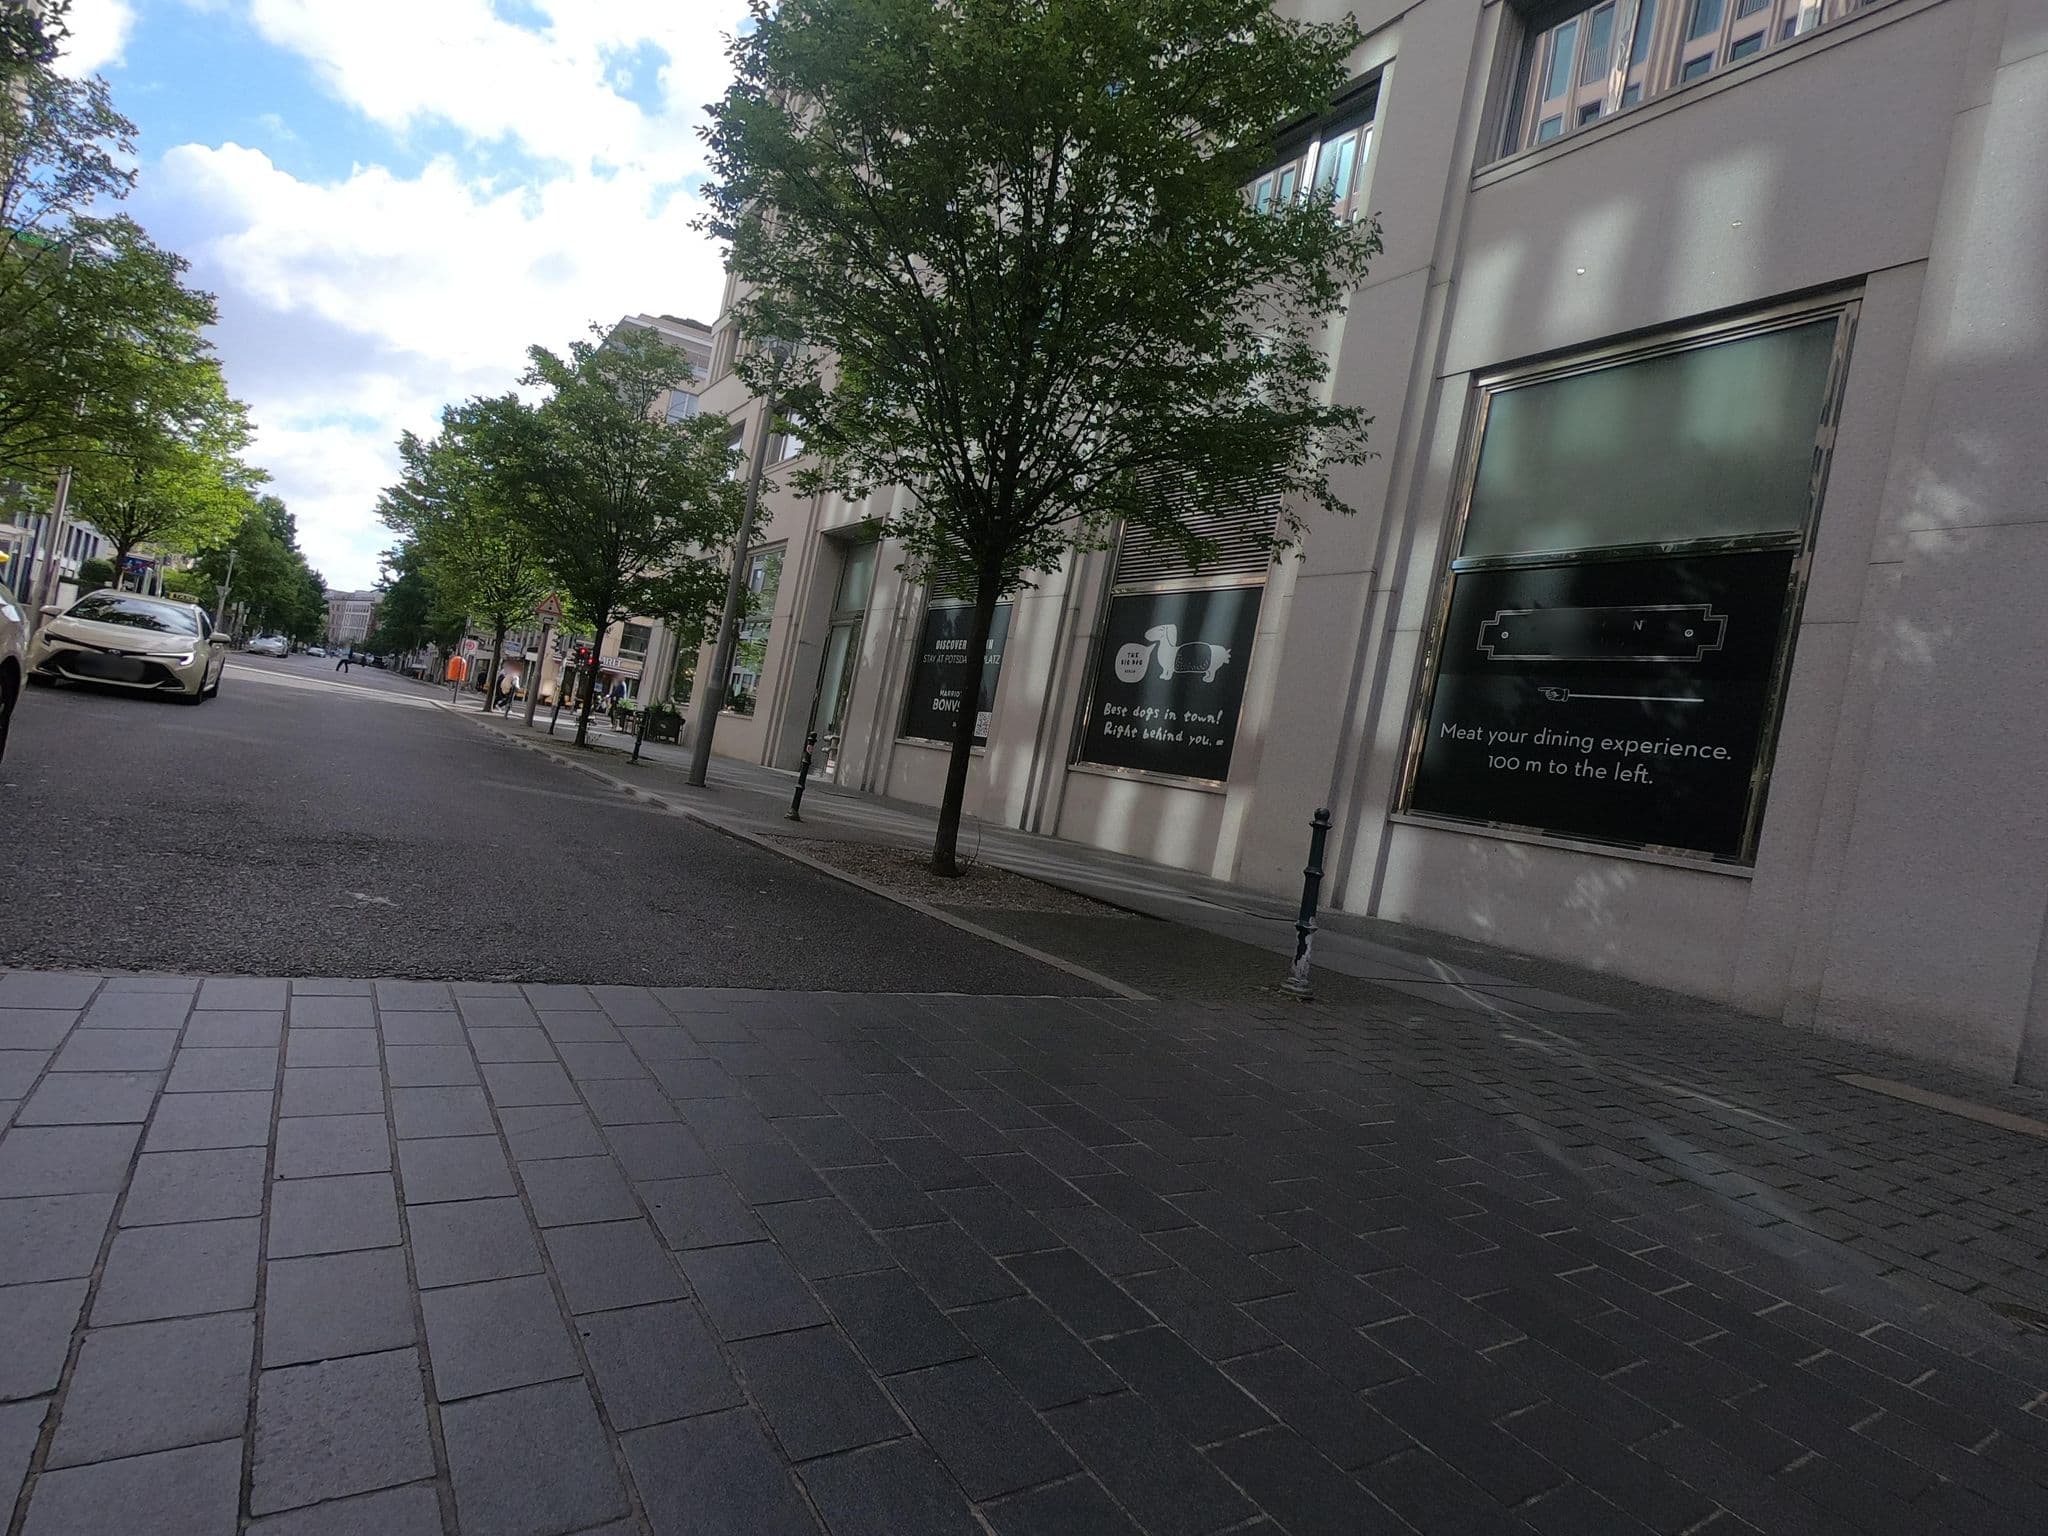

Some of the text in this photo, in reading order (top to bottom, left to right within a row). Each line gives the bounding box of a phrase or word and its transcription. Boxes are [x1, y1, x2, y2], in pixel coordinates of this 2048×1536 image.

[936, 639, 967, 650] DISCOVER
[923, 654, 936, 663] STAY
[936, 654, 944, 663] AT
[945, 654, 967, 663] POTSDA
[1103, 702, 1224, 725] Best dogs in town!
[1104, 721, 1137, 738] Right
[1142, 726, 1184, 742] behind
[1440, 722, 1733, 761] Meat your dining experience.
[1488, 755, 1654, 785] 100 m to the left.
